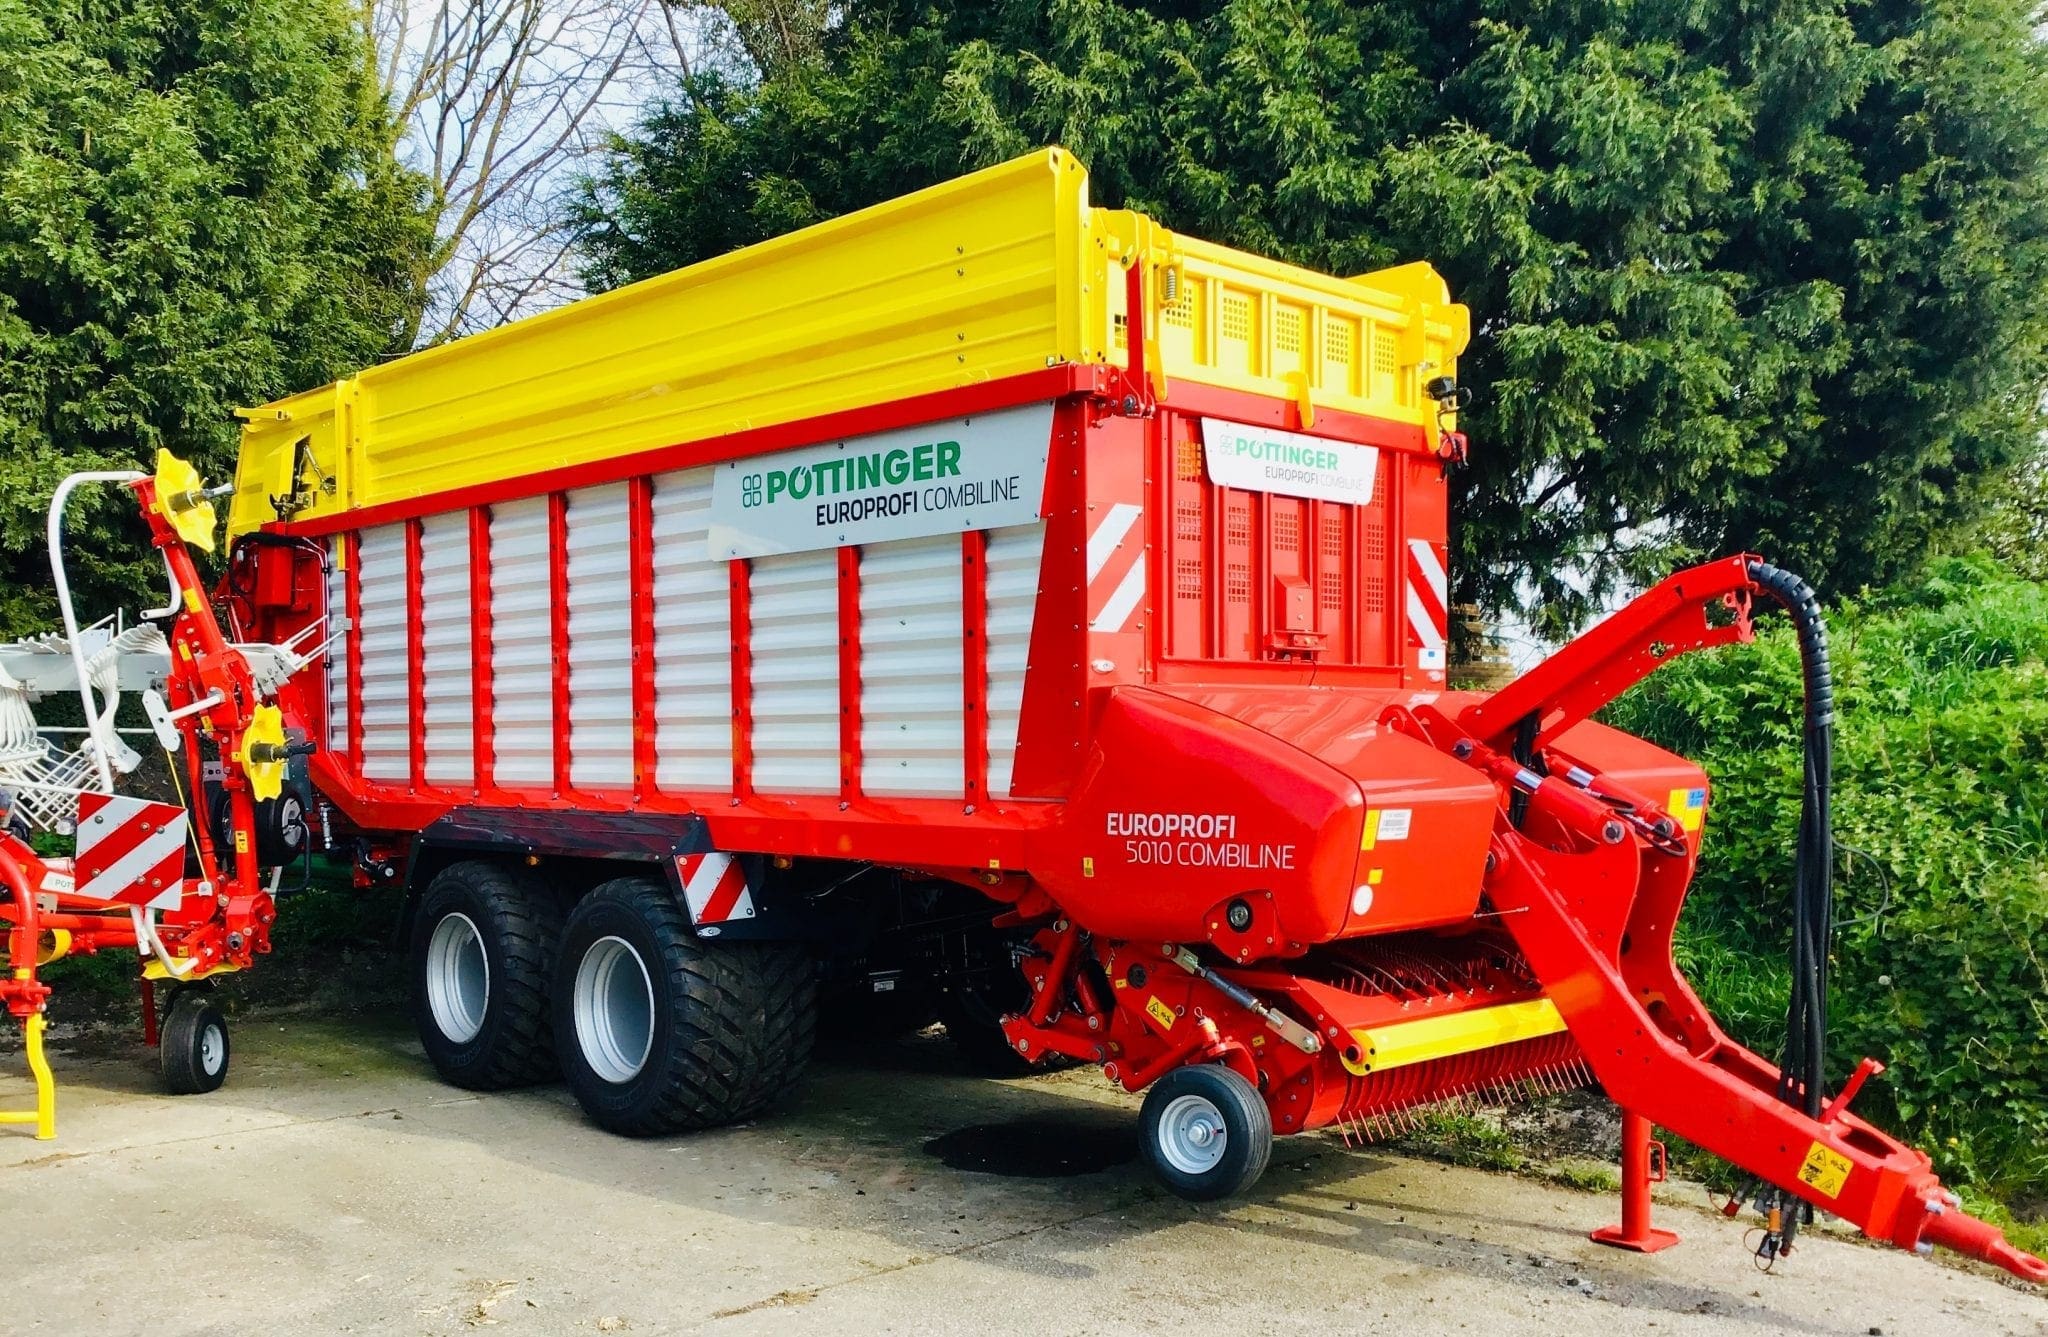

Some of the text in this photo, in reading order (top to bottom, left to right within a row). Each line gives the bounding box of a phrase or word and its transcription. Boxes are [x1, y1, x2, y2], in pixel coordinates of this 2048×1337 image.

[1235, 437, 1338, 470] PÖTTINGER
[767, 440, 961, 503] PÖTTINGER
[1265, 465, 1319, 485] EUROPROFI
[816, 475, 1020, 526] EUROPROFI COMBILINE
[1107, 812, 1236, 838] EUROPROFI
[1126, 840, 1296, 870] 5010 COMBILINE
